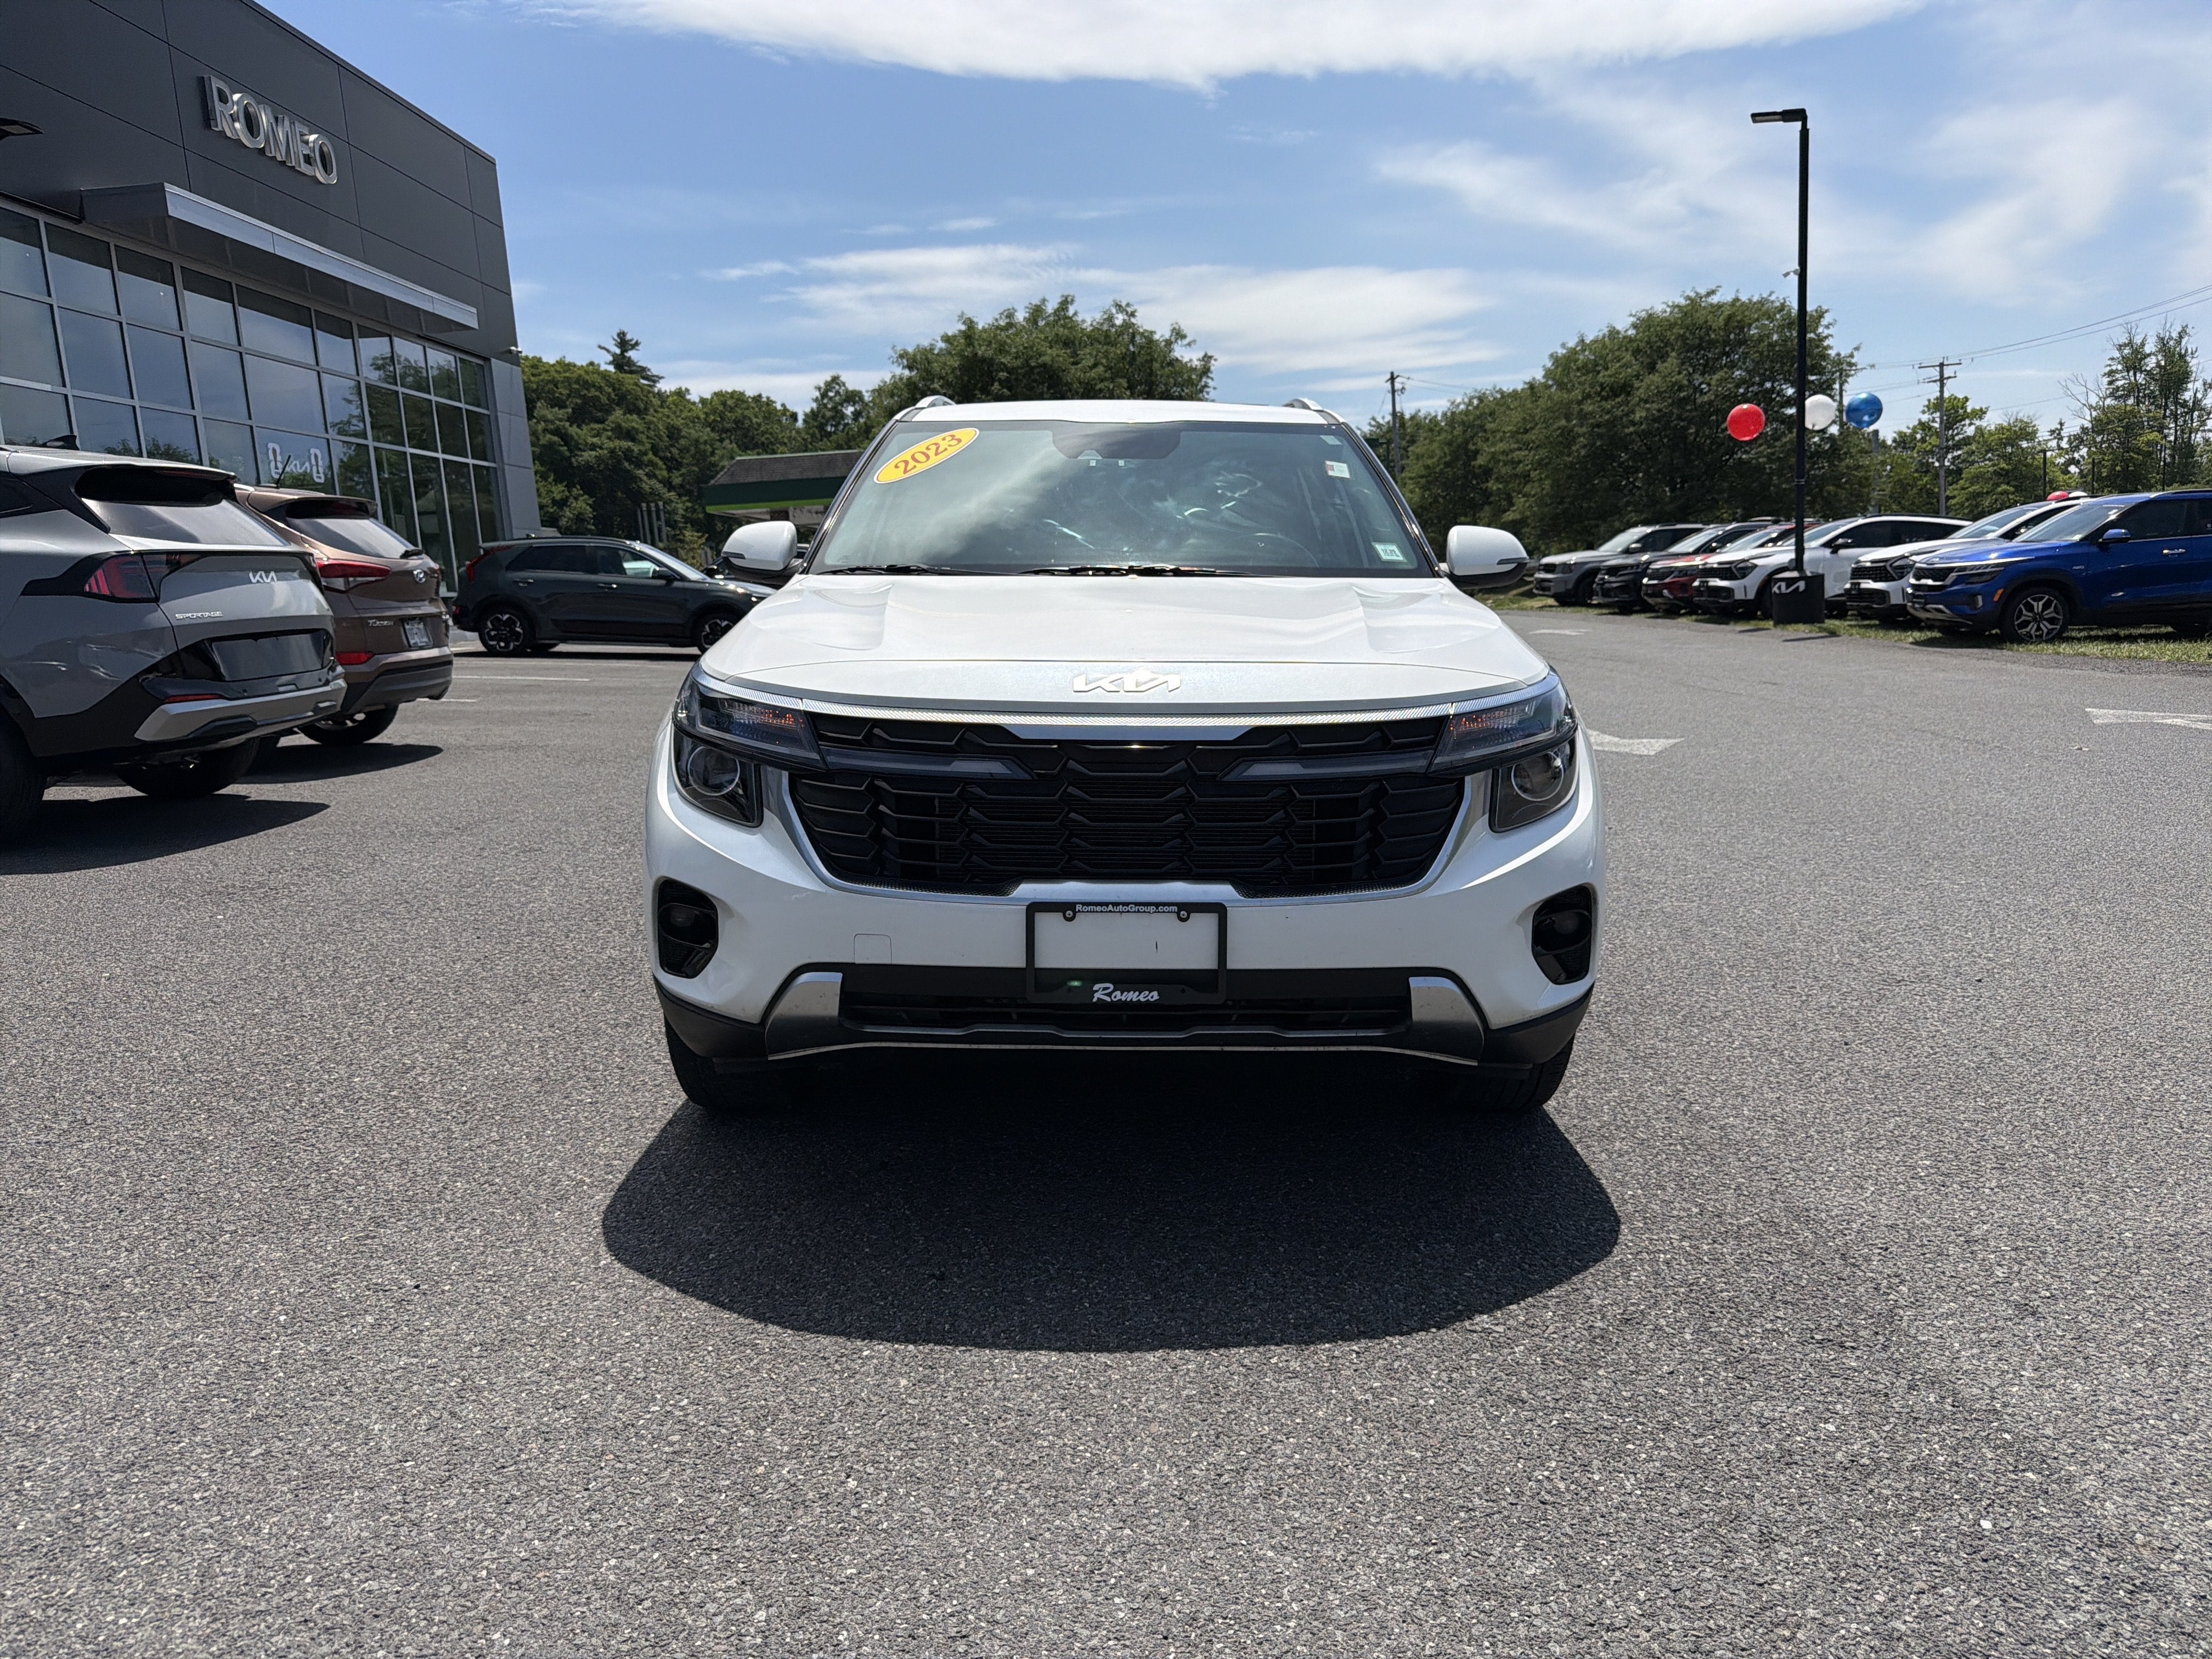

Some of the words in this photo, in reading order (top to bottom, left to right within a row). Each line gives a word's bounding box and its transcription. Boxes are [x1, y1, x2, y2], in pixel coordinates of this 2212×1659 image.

[204, 75, 337, 184] ROMEO
[894, 434, 962, 475] 2023
[249, 571, 276, 583] KIA
[176, 611, 223, 619] SPORTAGE
[1073, 674, 1182, 692] KIA
[1076, 904, 1177, 913] RomeoAutoGroup.com
[1092, 983, 1160, 1002] Romeo
